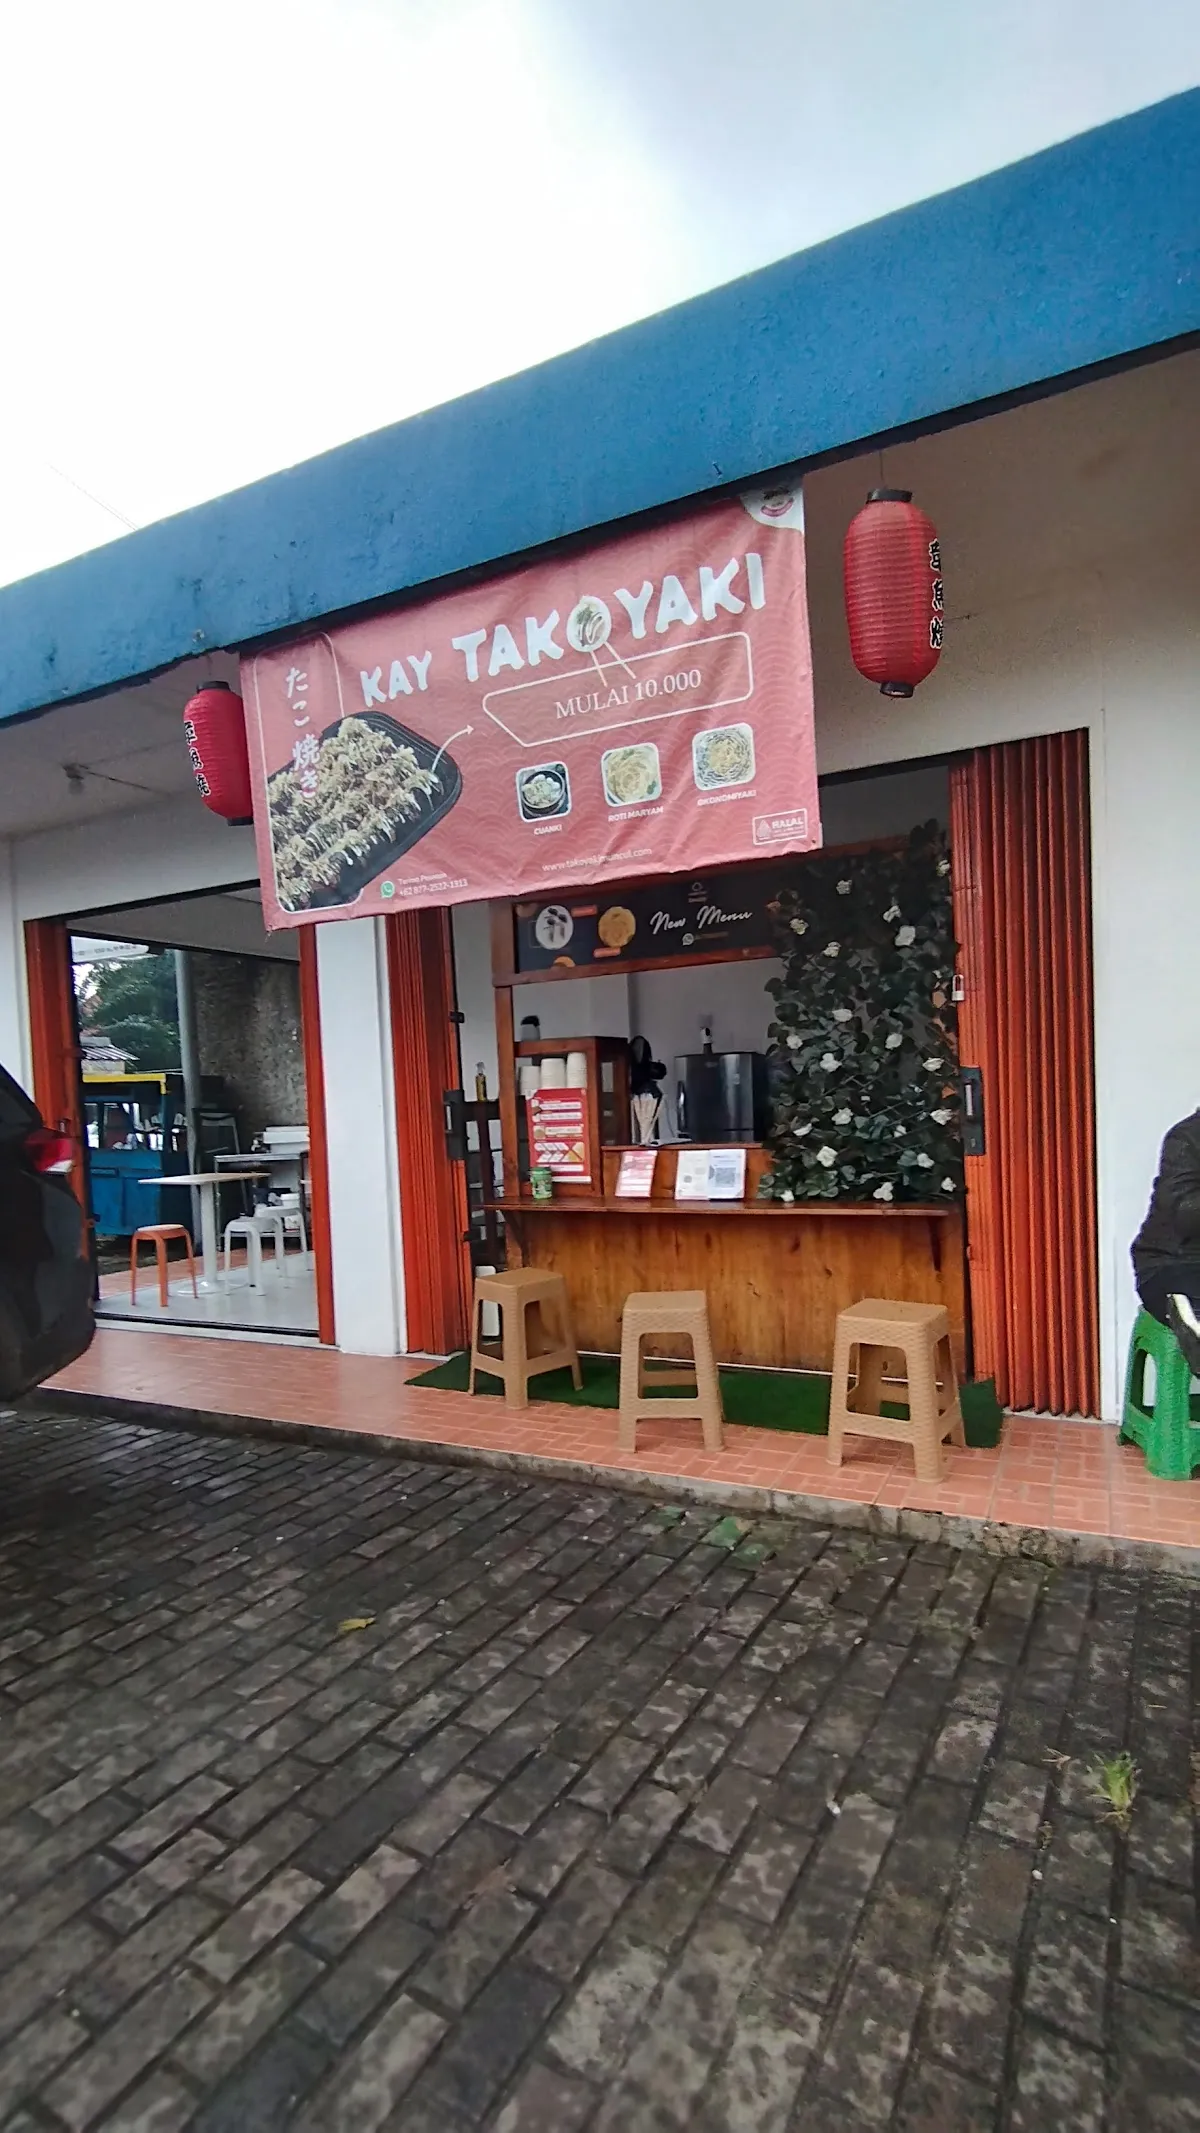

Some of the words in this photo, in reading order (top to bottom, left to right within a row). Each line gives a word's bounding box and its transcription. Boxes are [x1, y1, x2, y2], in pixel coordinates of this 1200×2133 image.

[360, 650, 433, 708] KAY
[451, 552, 767, 683] TAKOYAKI
[555, 687, 630, 719] MULAI
[634, 669, 702, 699] 10.000
[285, 666, 321, 799] たこ焼き
[533, 823, 563, 836] CUANKI
[607, 812, 628, 823] ROTI
[628, 805, 664, 820] MARYAM
[649, 910, 687, 936] New
[696, 904, 753, 929] Menu
